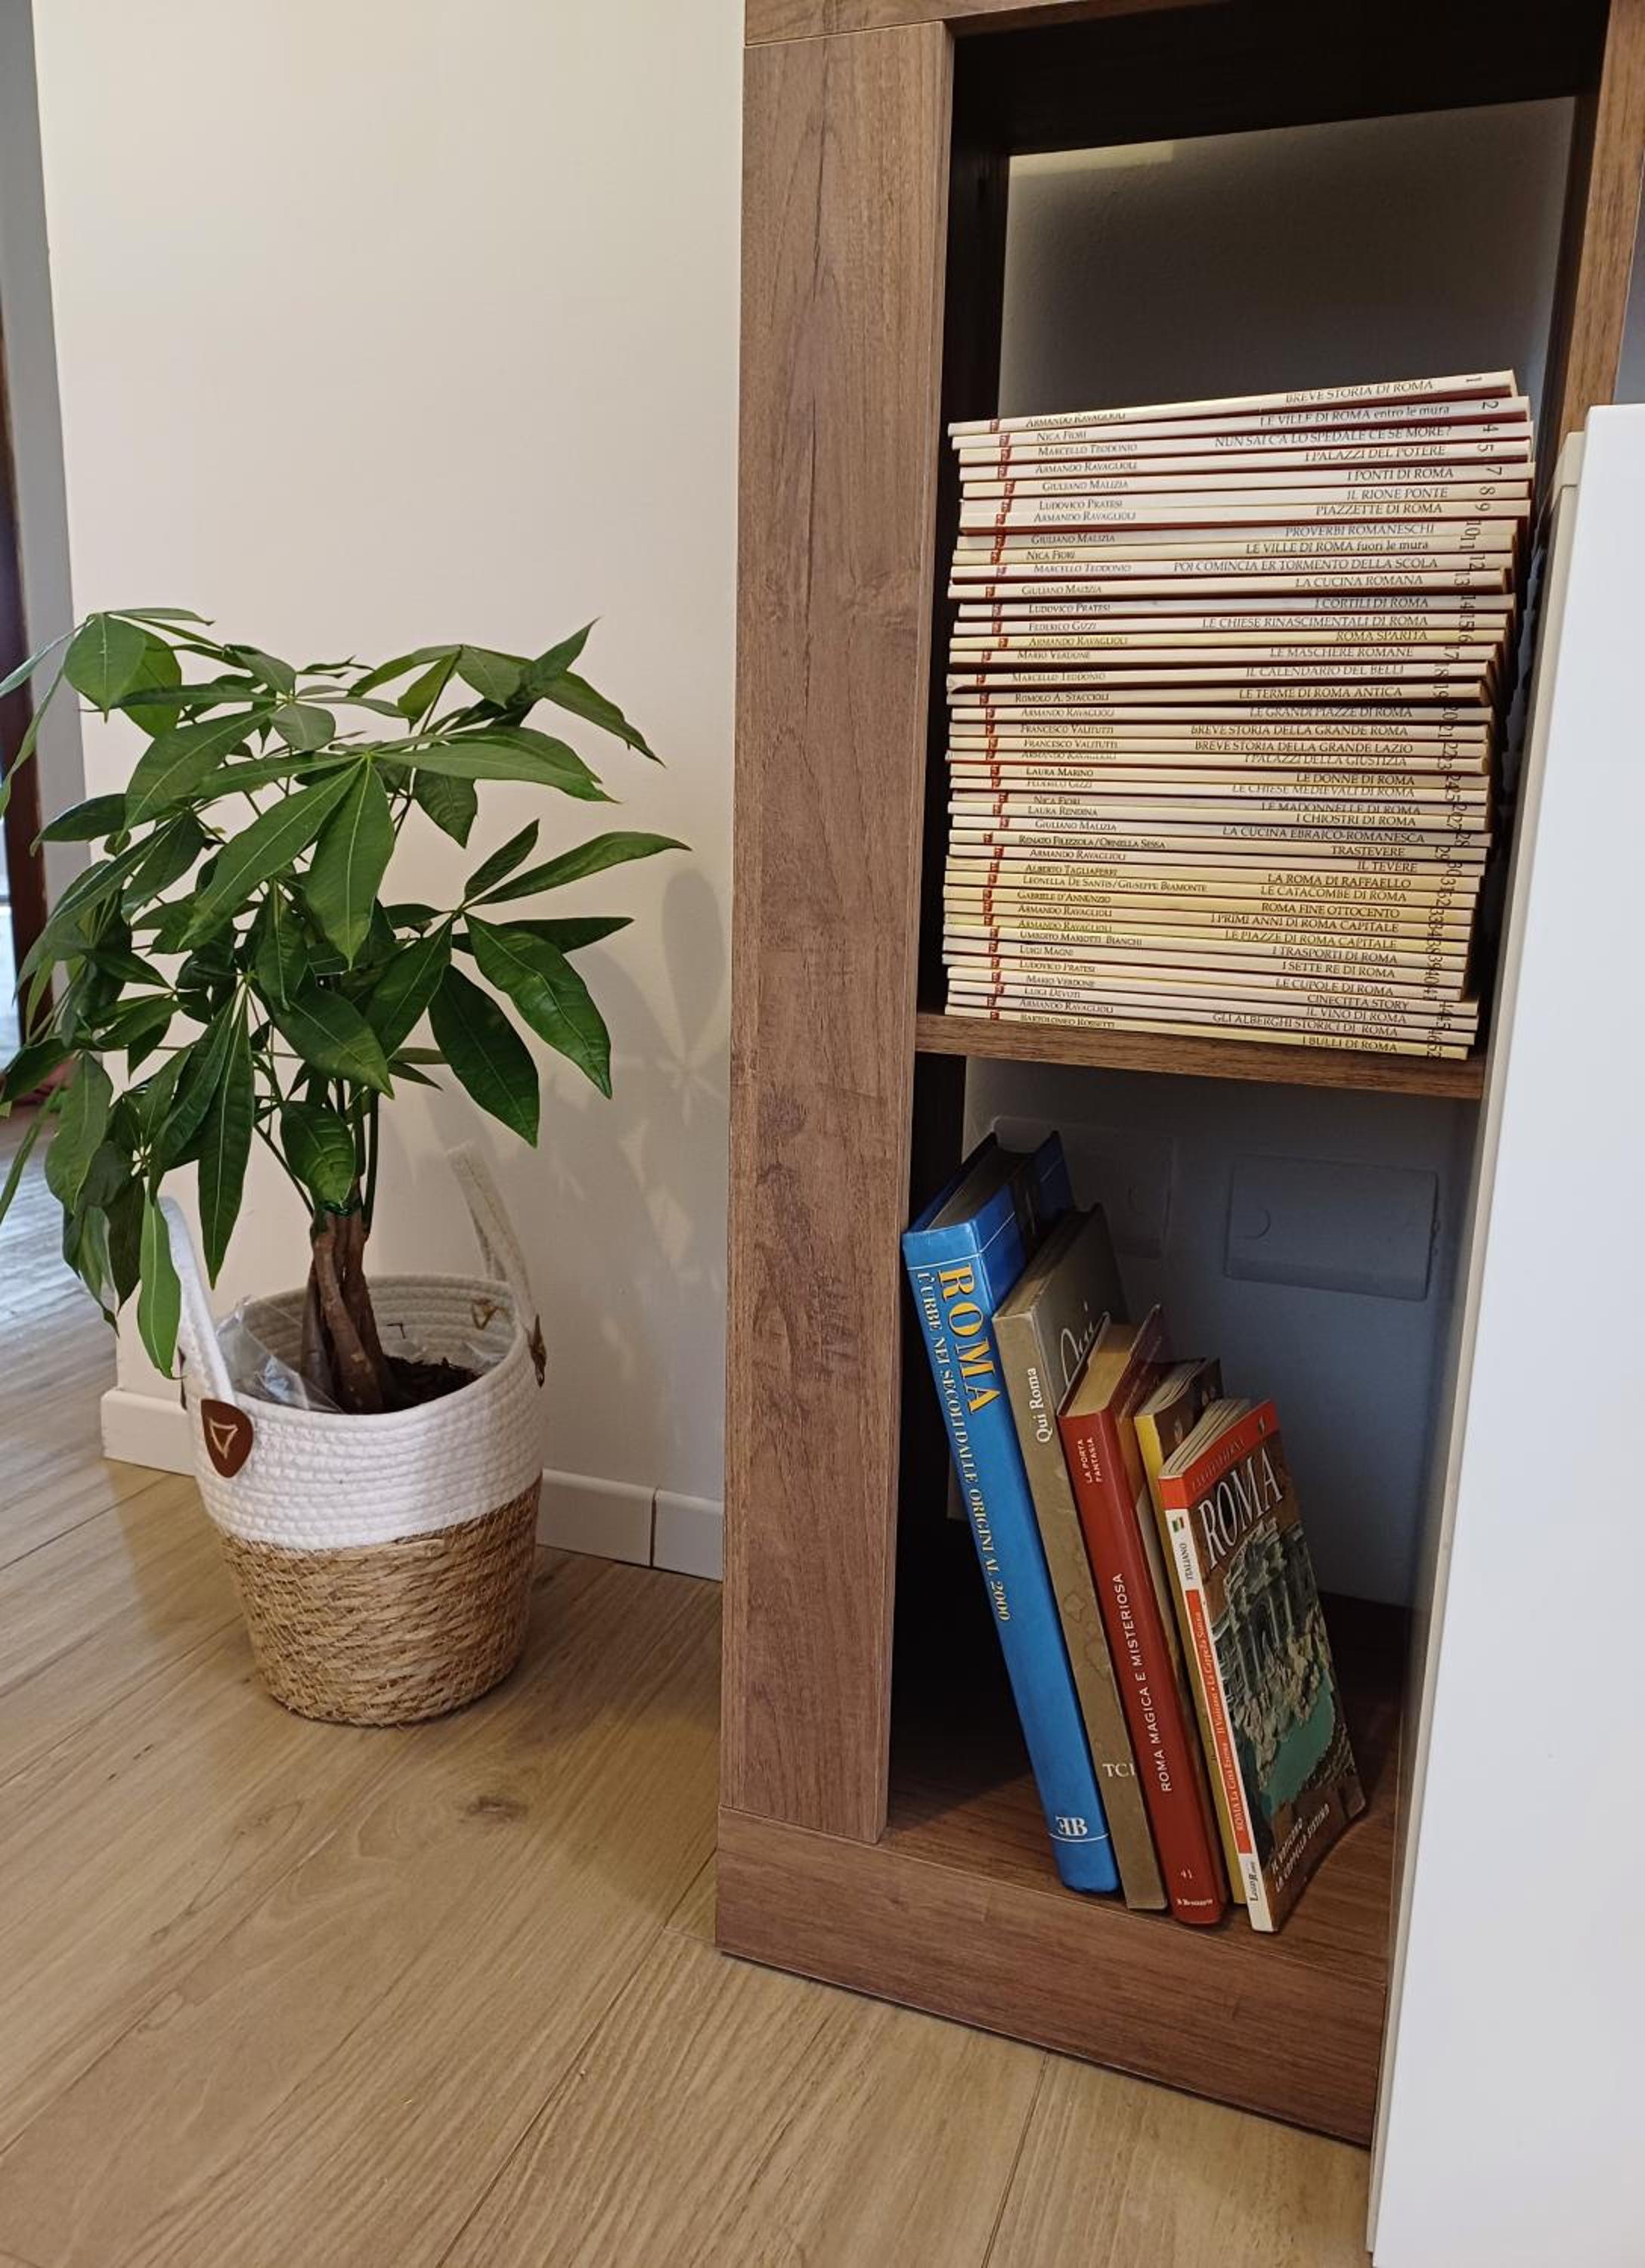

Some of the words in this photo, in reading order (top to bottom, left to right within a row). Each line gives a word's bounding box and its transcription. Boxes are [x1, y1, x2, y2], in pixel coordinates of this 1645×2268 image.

[1287, 393, 1324, 403] BREVE
[1327, 386, 1371, 398] STORIA
[1377, 386, 1389, 394] DI
[1394, 381, 1433, 392] ROMA
[1260, 417, 1274, 426] LE
[1279, 414, 1312, 425] VILLE
[1316, 414, 1328, 422] DI
[1332, 411, 1372, 420] ROMA
[1374, 410, 1403, 419] entro
[1408, 407, 1417, 416] le
[1420, 406, 1449, 414] mura
[1483, 424, 1498, 432] 4
[1312, 451, 1364, 461] PALAZZI
[1369, 449, 1393, 458] DEL
[1397, 447, 1445, 457] POTERE
[1355, 470, 1393, 481] PONTI
[1399, 469, 1411, 478] DI
[1414, 468, 1453, 478] ROMA
[1347, 491, 1356, 500] IL
[1362, 490, 1402, 499] RIONE
[1405, 488, 1448, 498] PONTE
[1316, 505, 1382, 516] PIAZZETTE
[1386, 505, 1399, 514] DI
[1403, 503, 1442, 513] ROMA
[1476, 503, 1489, 511] 9
[1286, 526, 1344, 537] PROVERBI
[1349, 524, 1433, 534] ROMANESCHI
[1247, 544, 1260, 553] LE
[1264, 543, 1296, 553] VILLE
[1300, 543, 1312, 552] DI
[1317, 542, 1353, 551] ROMA
[1386, 541, 1396, 550] le
[1174, 562, 1193, 571] POI
[1197, 561, 1258, 571] COMINCIA
[1280, 559, 1349, 570] TORMENTO
[1352, 559, 1391, 569] DELLA
[1395, 559, 1438, 567] SCOLA
[1324, 599, 1371, 608] CORTILI
[1374, 599, 1386, 608] DI
[1390, 598, 1428, 607] ROMA
[1336, 632, 1374, 642] ROMA
[1377, 631, 1427, 640] SPARITA
[1240, 689, 1253, 699] LE
[1256, 689, 1294, 699] TERME
[1298, 689, 1310, 697] DI
[1314, 689, 1350, 697] ROMA
[1354, 688, 1402, 697] ANTICA
[1191, 726, 1226, 734] BREVE
[1228, 726, 1270, 734] STORIA
[1274, 726, 1312, 735] DELLA
[1315, 726, 1368, 735] GRANDE
[1371, 726, 1408, 735] ROMA
[1196, 741, 1231, 750] BREVE
[1278, 742, 1315, 751] DELLA
[1320, 743, 1371, 751] GRANDE
[1375, 744, 1413, 753] LAZIO
[1296, 773, 1310, 782] LE
[1314, 774, 1358, 783] DONNE
[1377, 776, 1414, 785] ROMA
[1303, 815, 1358, 824] CHIOSTRI
[1362, 816, 1374, 825] DI
[1378, 817, 1416, 826] ROMA
[1331, 846, 1405, 856] TRASTEVERE
[1373, 863, 1417, 872] TEVERE
[1261, 886, 1275, 895] LE
[1278, 888, 1350, 898] CATACOMBE
[1370, 892, 1407, 901] ROMA
[1262, 903, 1296, 912] ROMA
[1300, 905, 1324, 913] FINE
[1327, 906, 1399, 918] OTTOCENTO
[1218, 915, 1248, 924] PRIMI
[1252, 917, 1282, 925] ANNI
[1302, 919, 1337, 928] ROMA
[1340, 921, 1399, 932] CAPITALE
[1288, 962, 1321, 972] SETTE
[1326, 965, 1340, 973] RE
[1359, 967, 1395, 978] ROMA
[938, 1262, 1001, 1414] ROMA
[932, 1337, 950, 1364] NEI
[1028, 1368, 1043, 1409] Roma
[942, 1368, 965, 1427] SECOLI
[1036, 1413, 1052, 1442] Qui
[956, 1430, 978, 1483] DALLE
[1077, 1439, 1087, 1468] PORTA
[1087, 1437, 1102, 1483] FANTASIA
[1085, 1470, 1093, 1483] LA
[1198, 1448, 1282, 1569] ROMA
[969, 1489, 993, 1551] ORIGINI
[985, 1555, 999, 1576] AL
[1179, 1543, 1194, 1580] ITALIANO
[990, 1581, 1010, 1621] 2000
[1113, 1573, 1142, 1665] MISTERIOSA
[1138, 1687, 1160, 1743] MAGICA
[1154, 1750, 1172, 1792] ROMA
